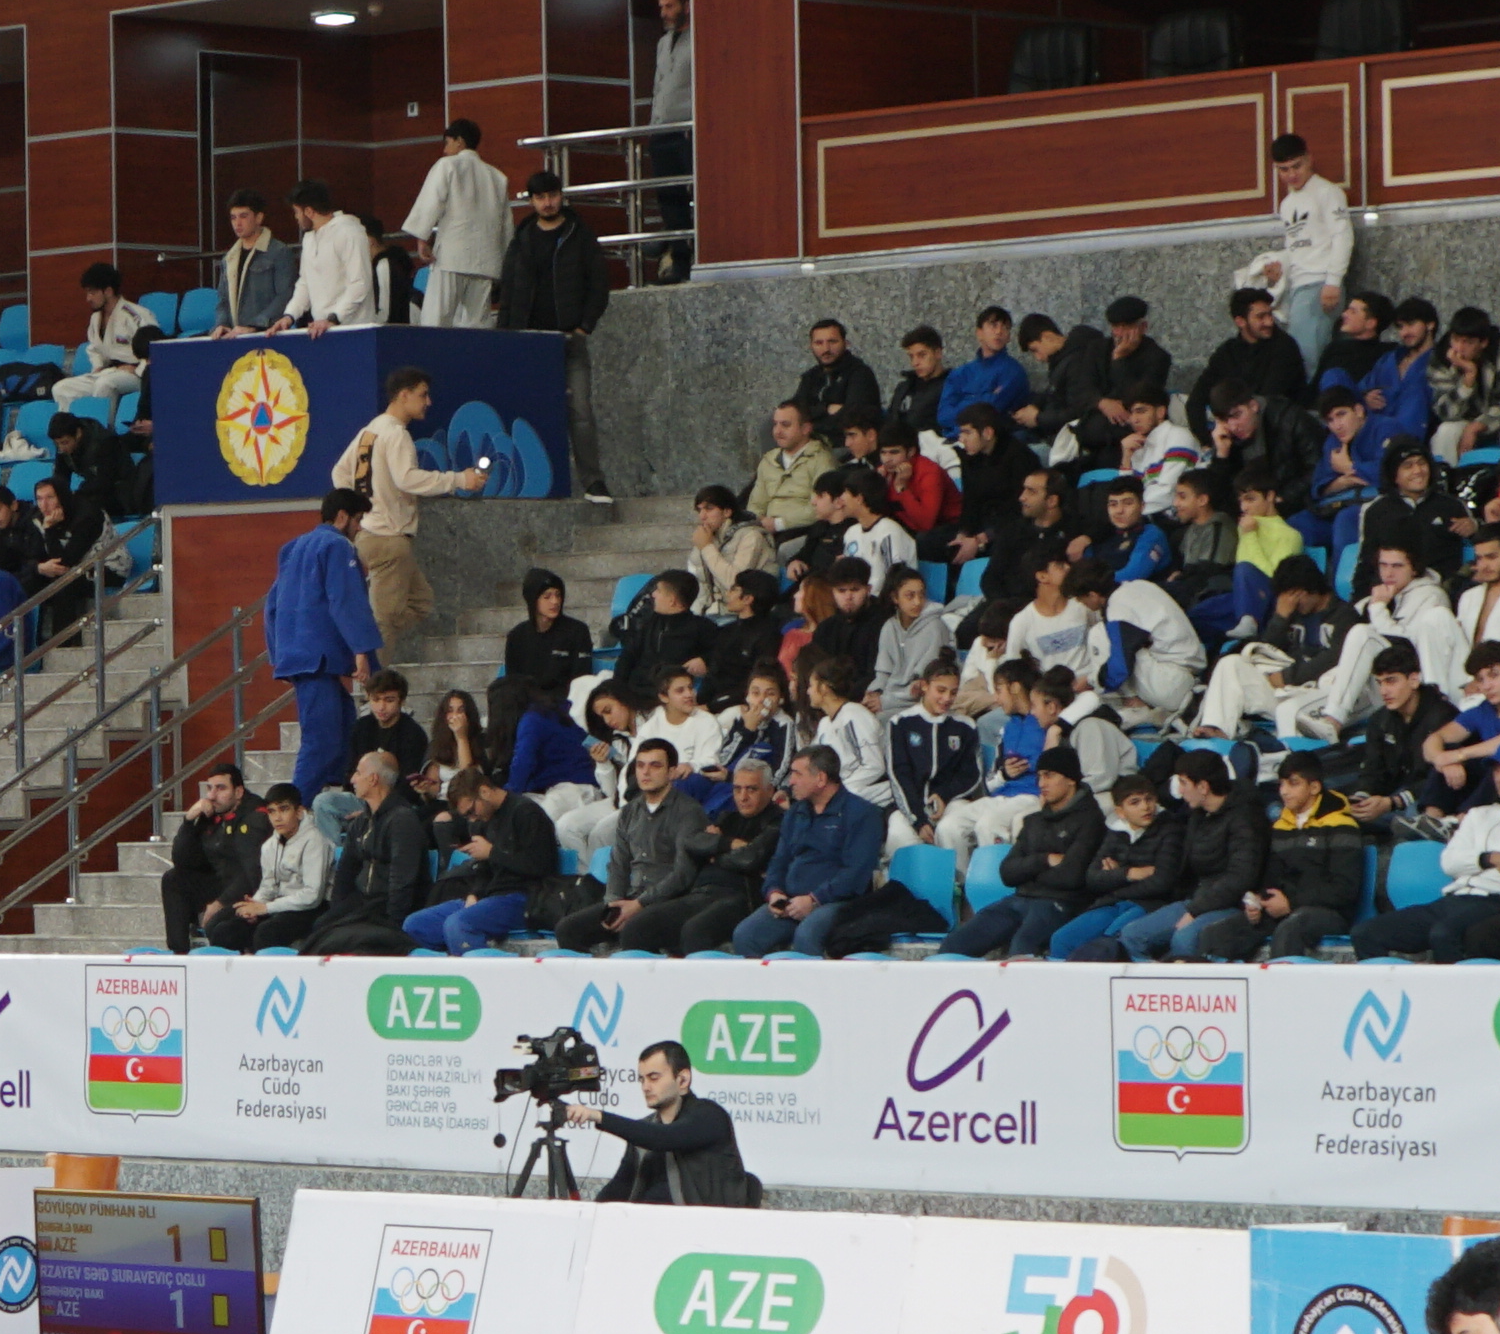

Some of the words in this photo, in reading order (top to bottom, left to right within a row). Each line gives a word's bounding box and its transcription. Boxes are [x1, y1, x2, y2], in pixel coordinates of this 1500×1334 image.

[95, 978, 178, 996] AZERBAIJAN
[386, 986, 461, 1030] AZE
[1124, 993, 1238, 1014] AZERBAIJAN
[706, 1012, 798, 1063] AZE
[238, 1053, 324, 1074] Azərbaycan
[261, 1076, 301, 1096] Cüdo
[1320, 1079, 1437, 1106] Azərbaycan
[235, 1100, 327, 1124] Federasiyası
[873, 1096, 1037, 1145] Azercell
[1351, 1107, 1403, 1129] Cüdo
[1315, 1133, 1437, 1162] Federasiyası
[53, 1237, 78, 1253] AZE
[166, 1224, 183, 1263] 1
[390, 1239, 480, 1260] AZERBAIJAN
[679, 1268, 798, 1332] AZE
[1336, 1288, 1364, 1302] Cüdo
[56, 1301, 81, 1318] AZE
[169, 1289, 185, 1329] 1
